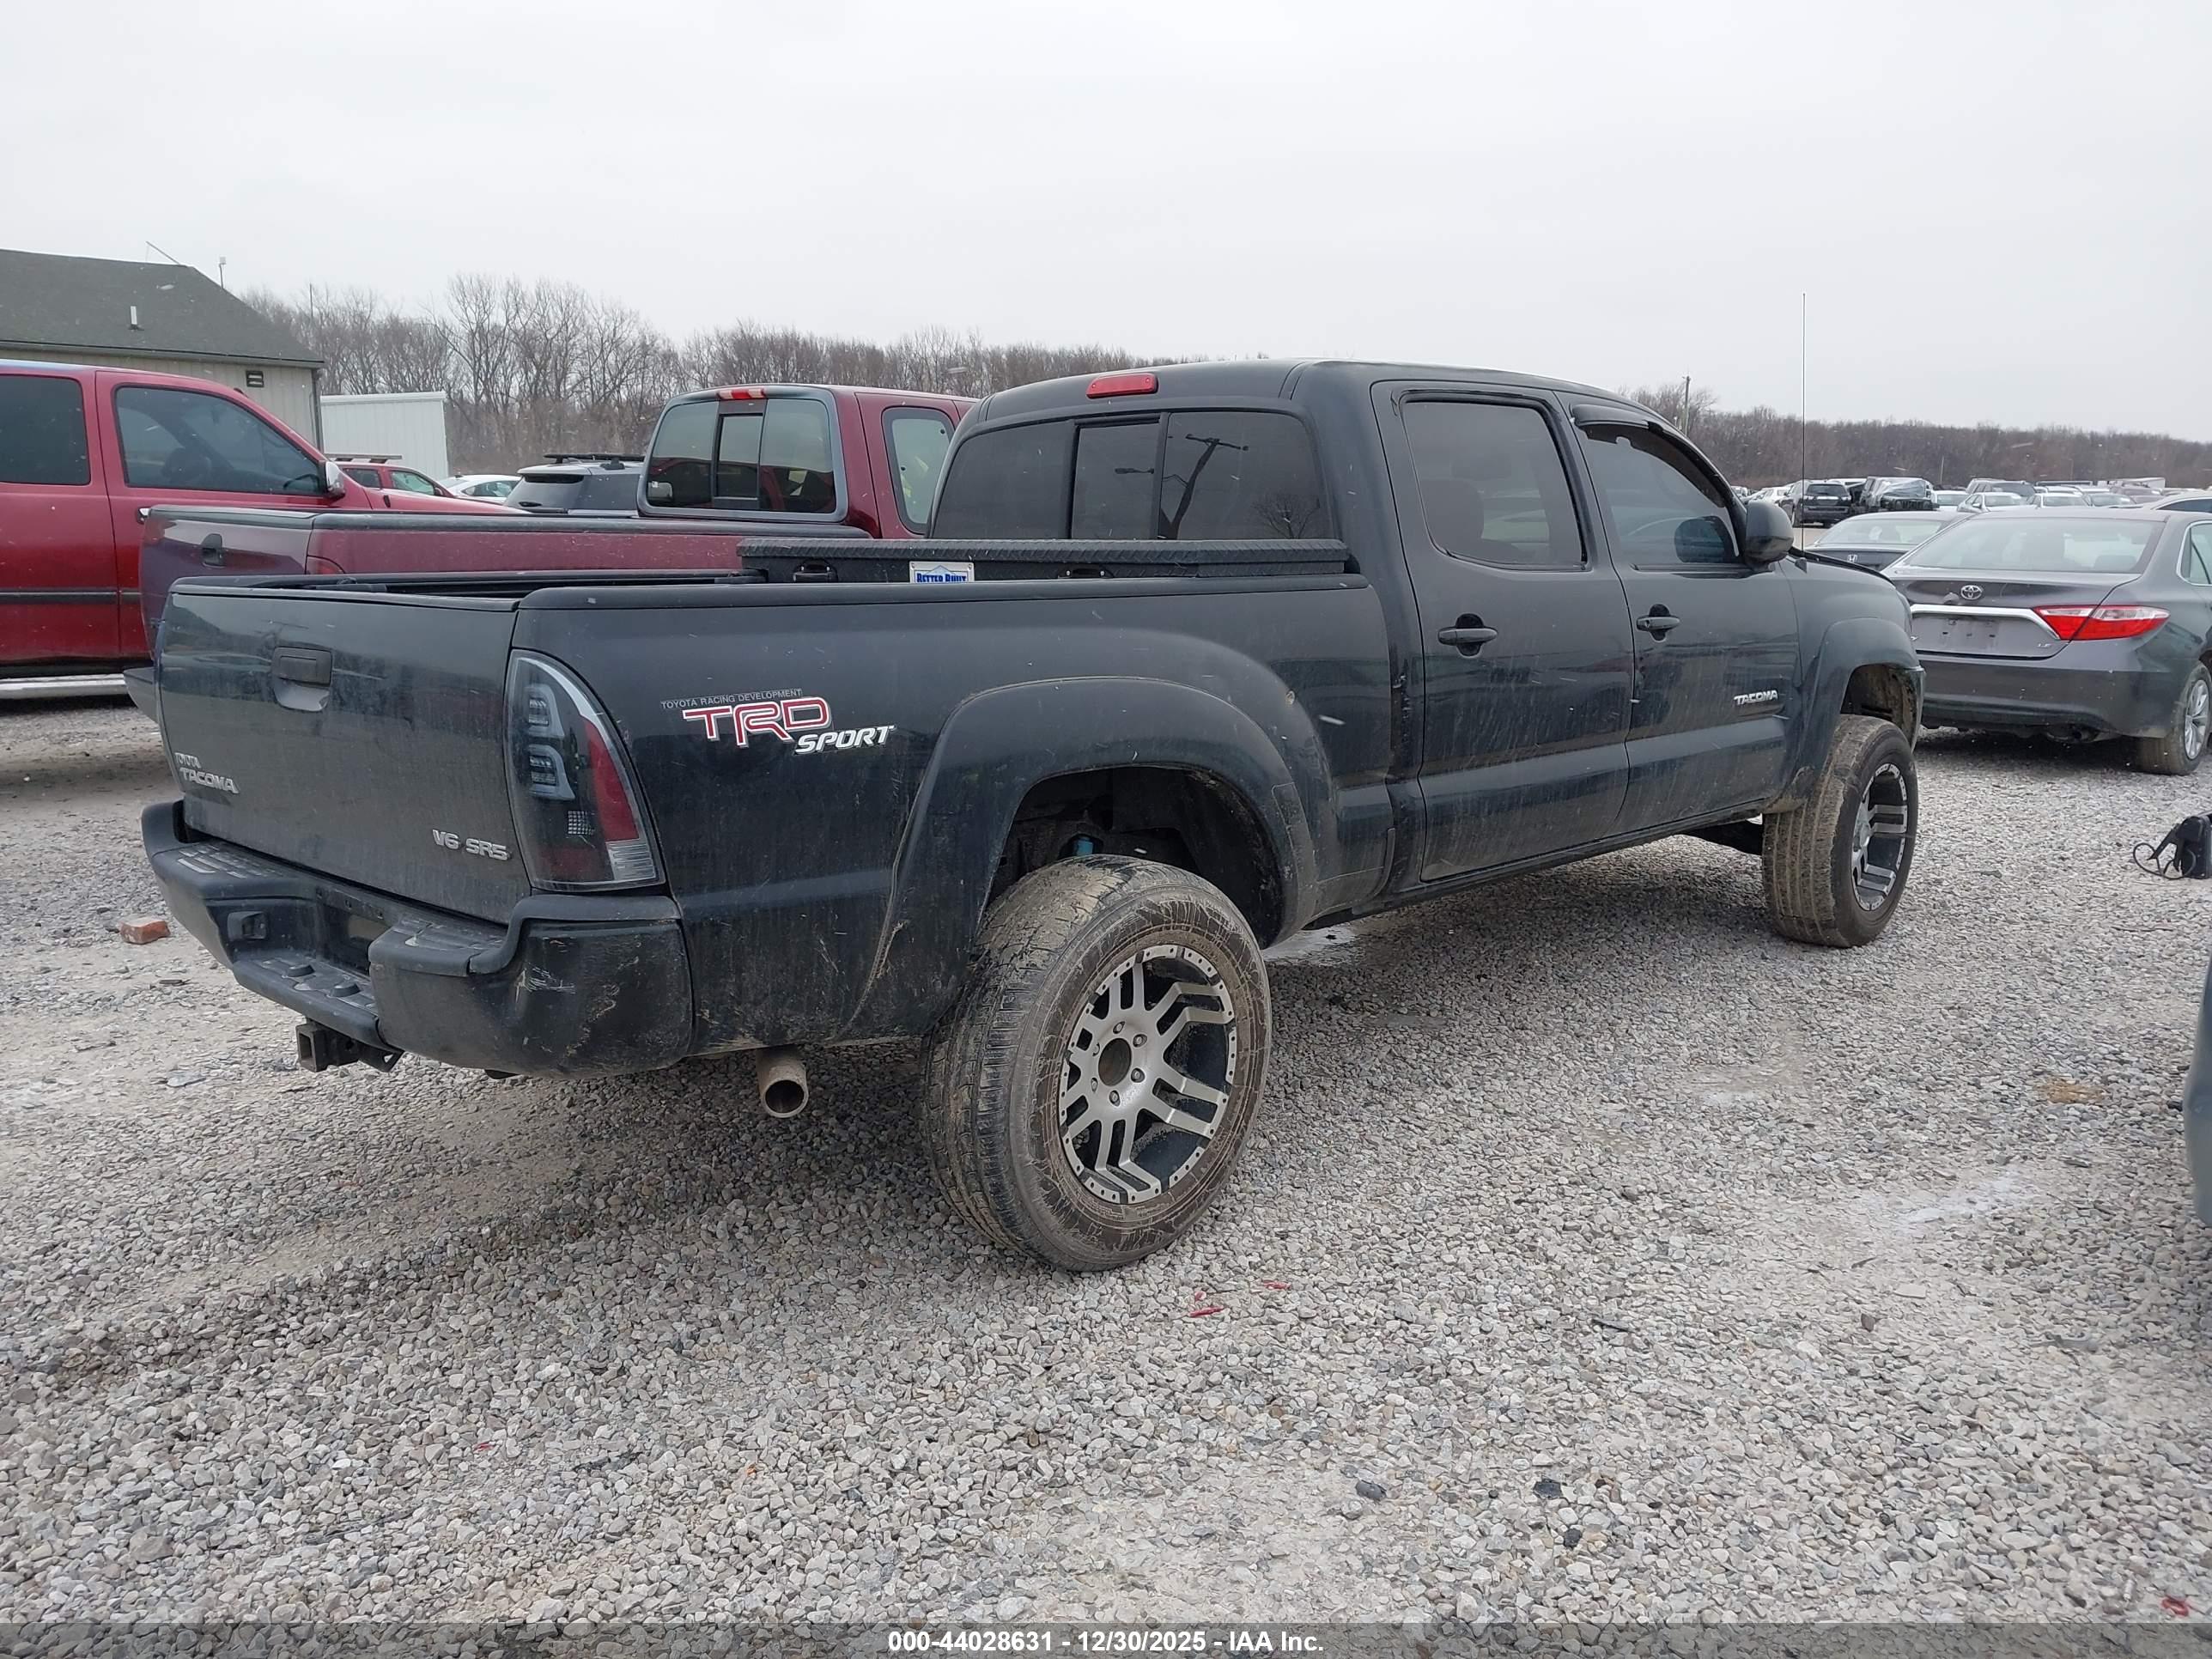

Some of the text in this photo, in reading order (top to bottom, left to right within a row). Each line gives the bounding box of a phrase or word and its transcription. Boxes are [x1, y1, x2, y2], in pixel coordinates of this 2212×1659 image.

[660, 689, 802, 710] TOYOTA RACING DEVELOPMENT
[1734, 690, 1778, 705] TACOMA
[682, 696, 831, 748] TRD
[793, 725, 896, 756] SPORT
[179, 767, 240, 794] TACOMA
[432, 829, 509, 861] V6 SR5
